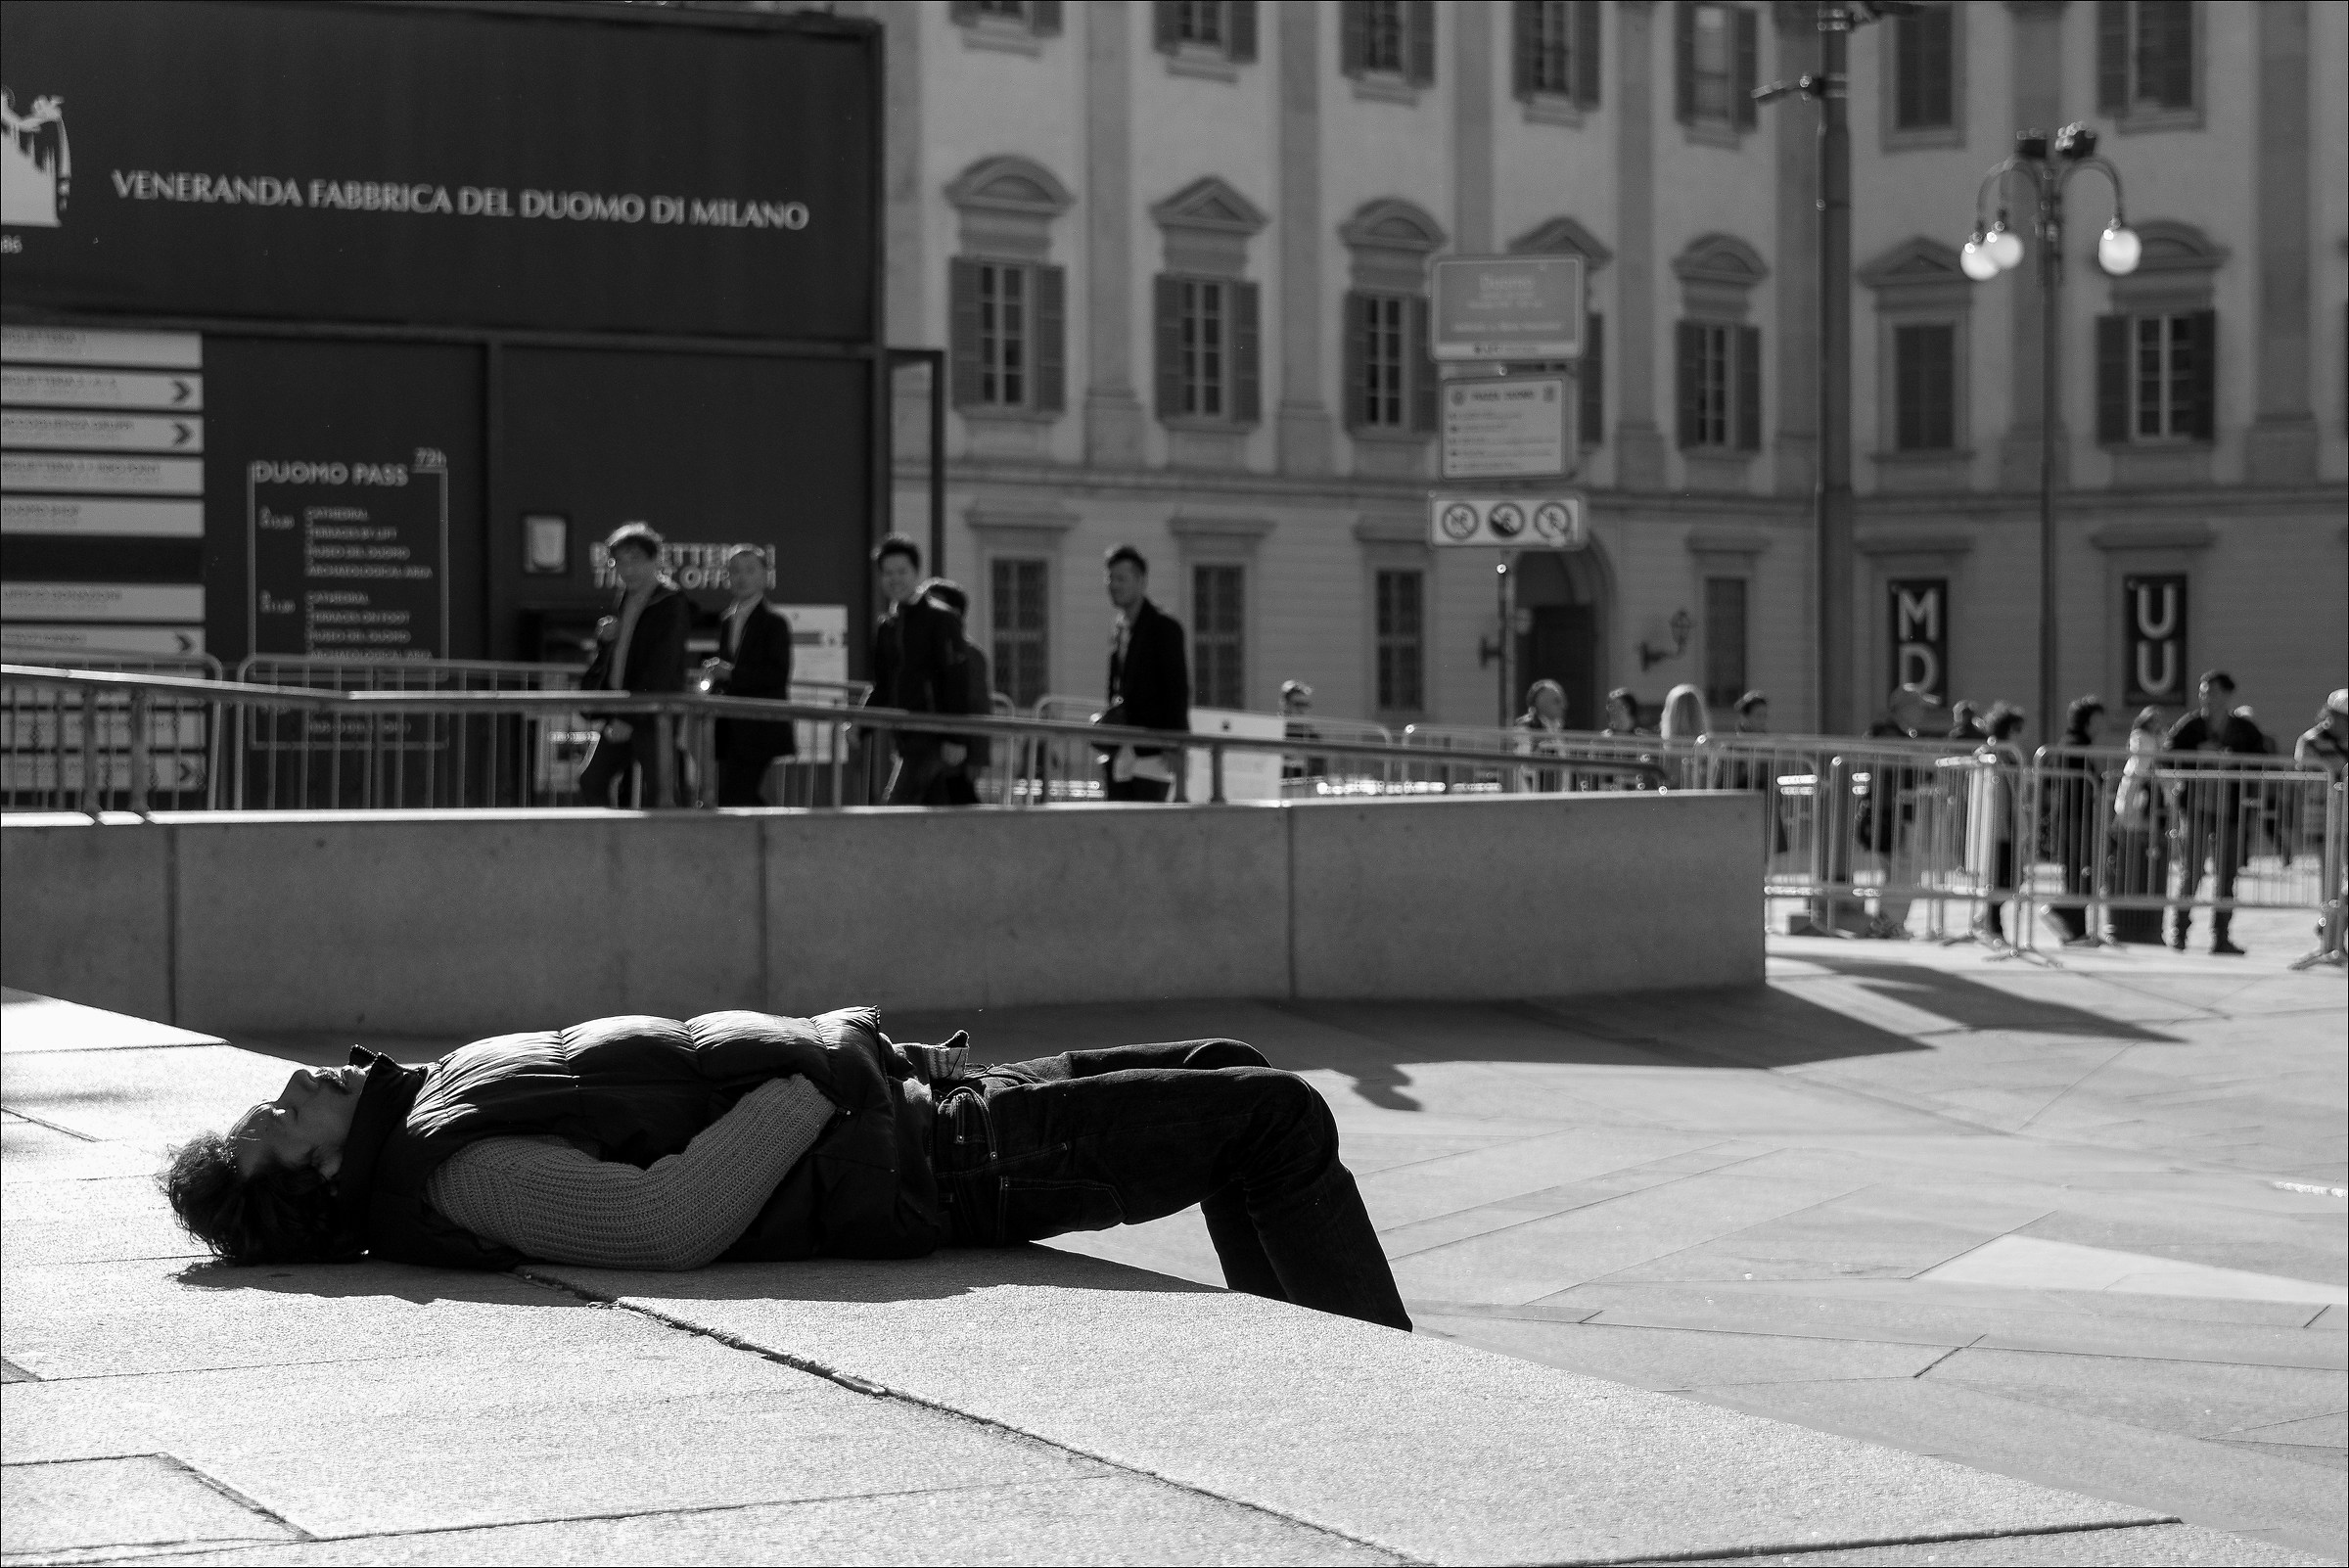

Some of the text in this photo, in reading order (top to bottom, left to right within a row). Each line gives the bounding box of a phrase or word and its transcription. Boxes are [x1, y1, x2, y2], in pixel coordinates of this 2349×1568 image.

[111, 168, 809, 230] VENERANDA FABBRICA DEL DUOMO DI MILANO
[253, 460, 409, 486] DUOMO PASS
